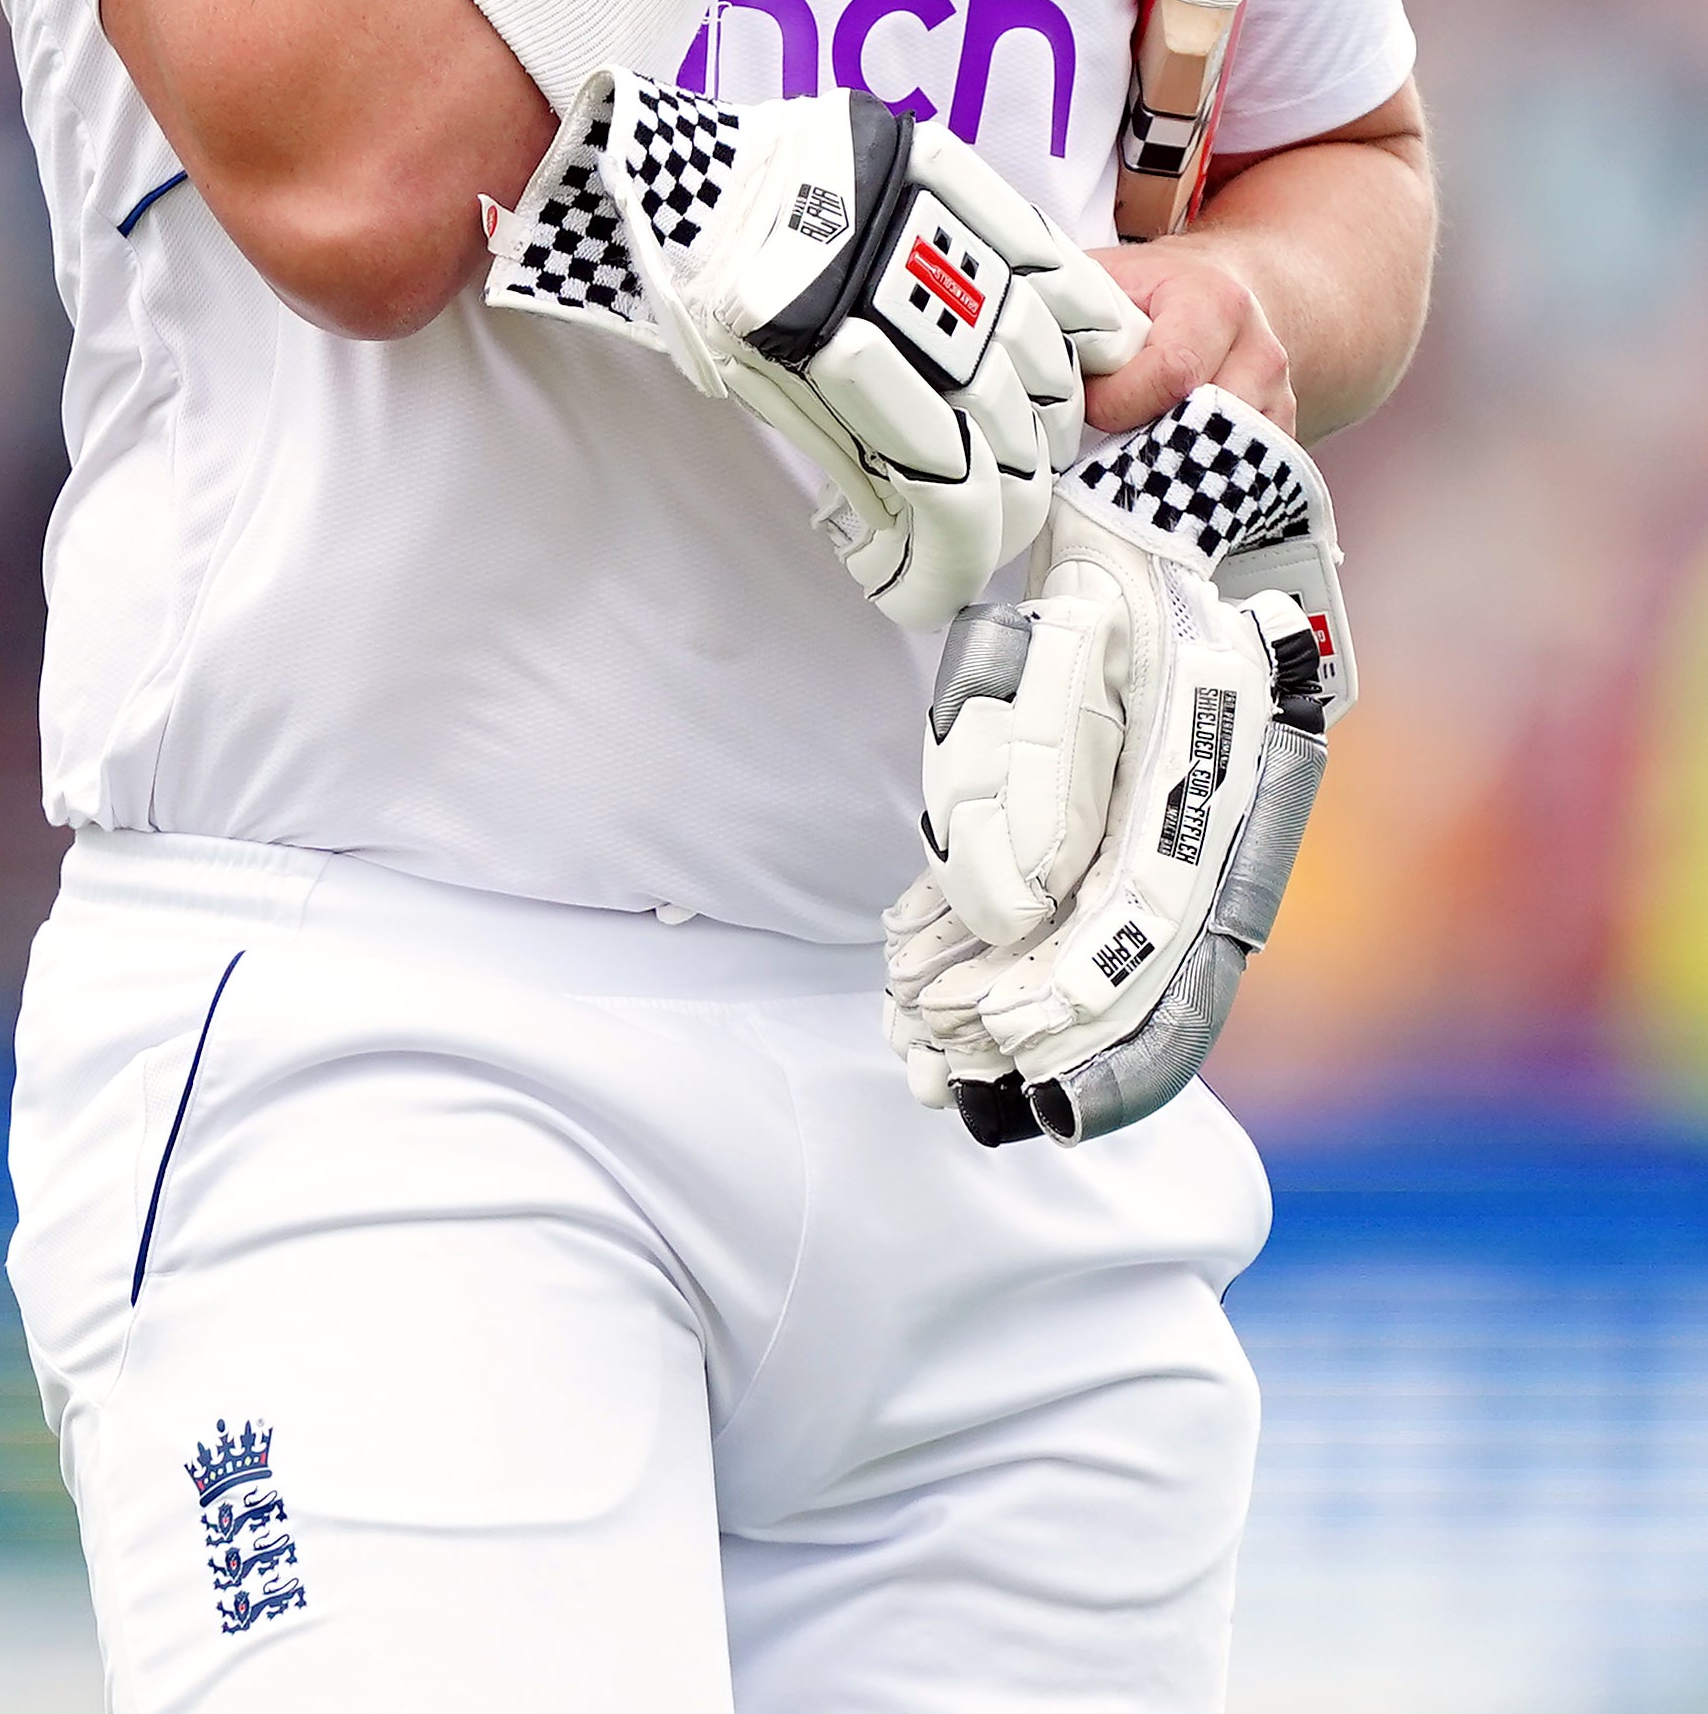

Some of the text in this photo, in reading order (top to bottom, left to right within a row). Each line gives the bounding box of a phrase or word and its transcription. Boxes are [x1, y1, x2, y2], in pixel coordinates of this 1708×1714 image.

[800, 186, 843, 243] ALPHA
[1194, 686, 1219, 760] SHIELDED
[1091, 920, 1148, 978] ALPHA
